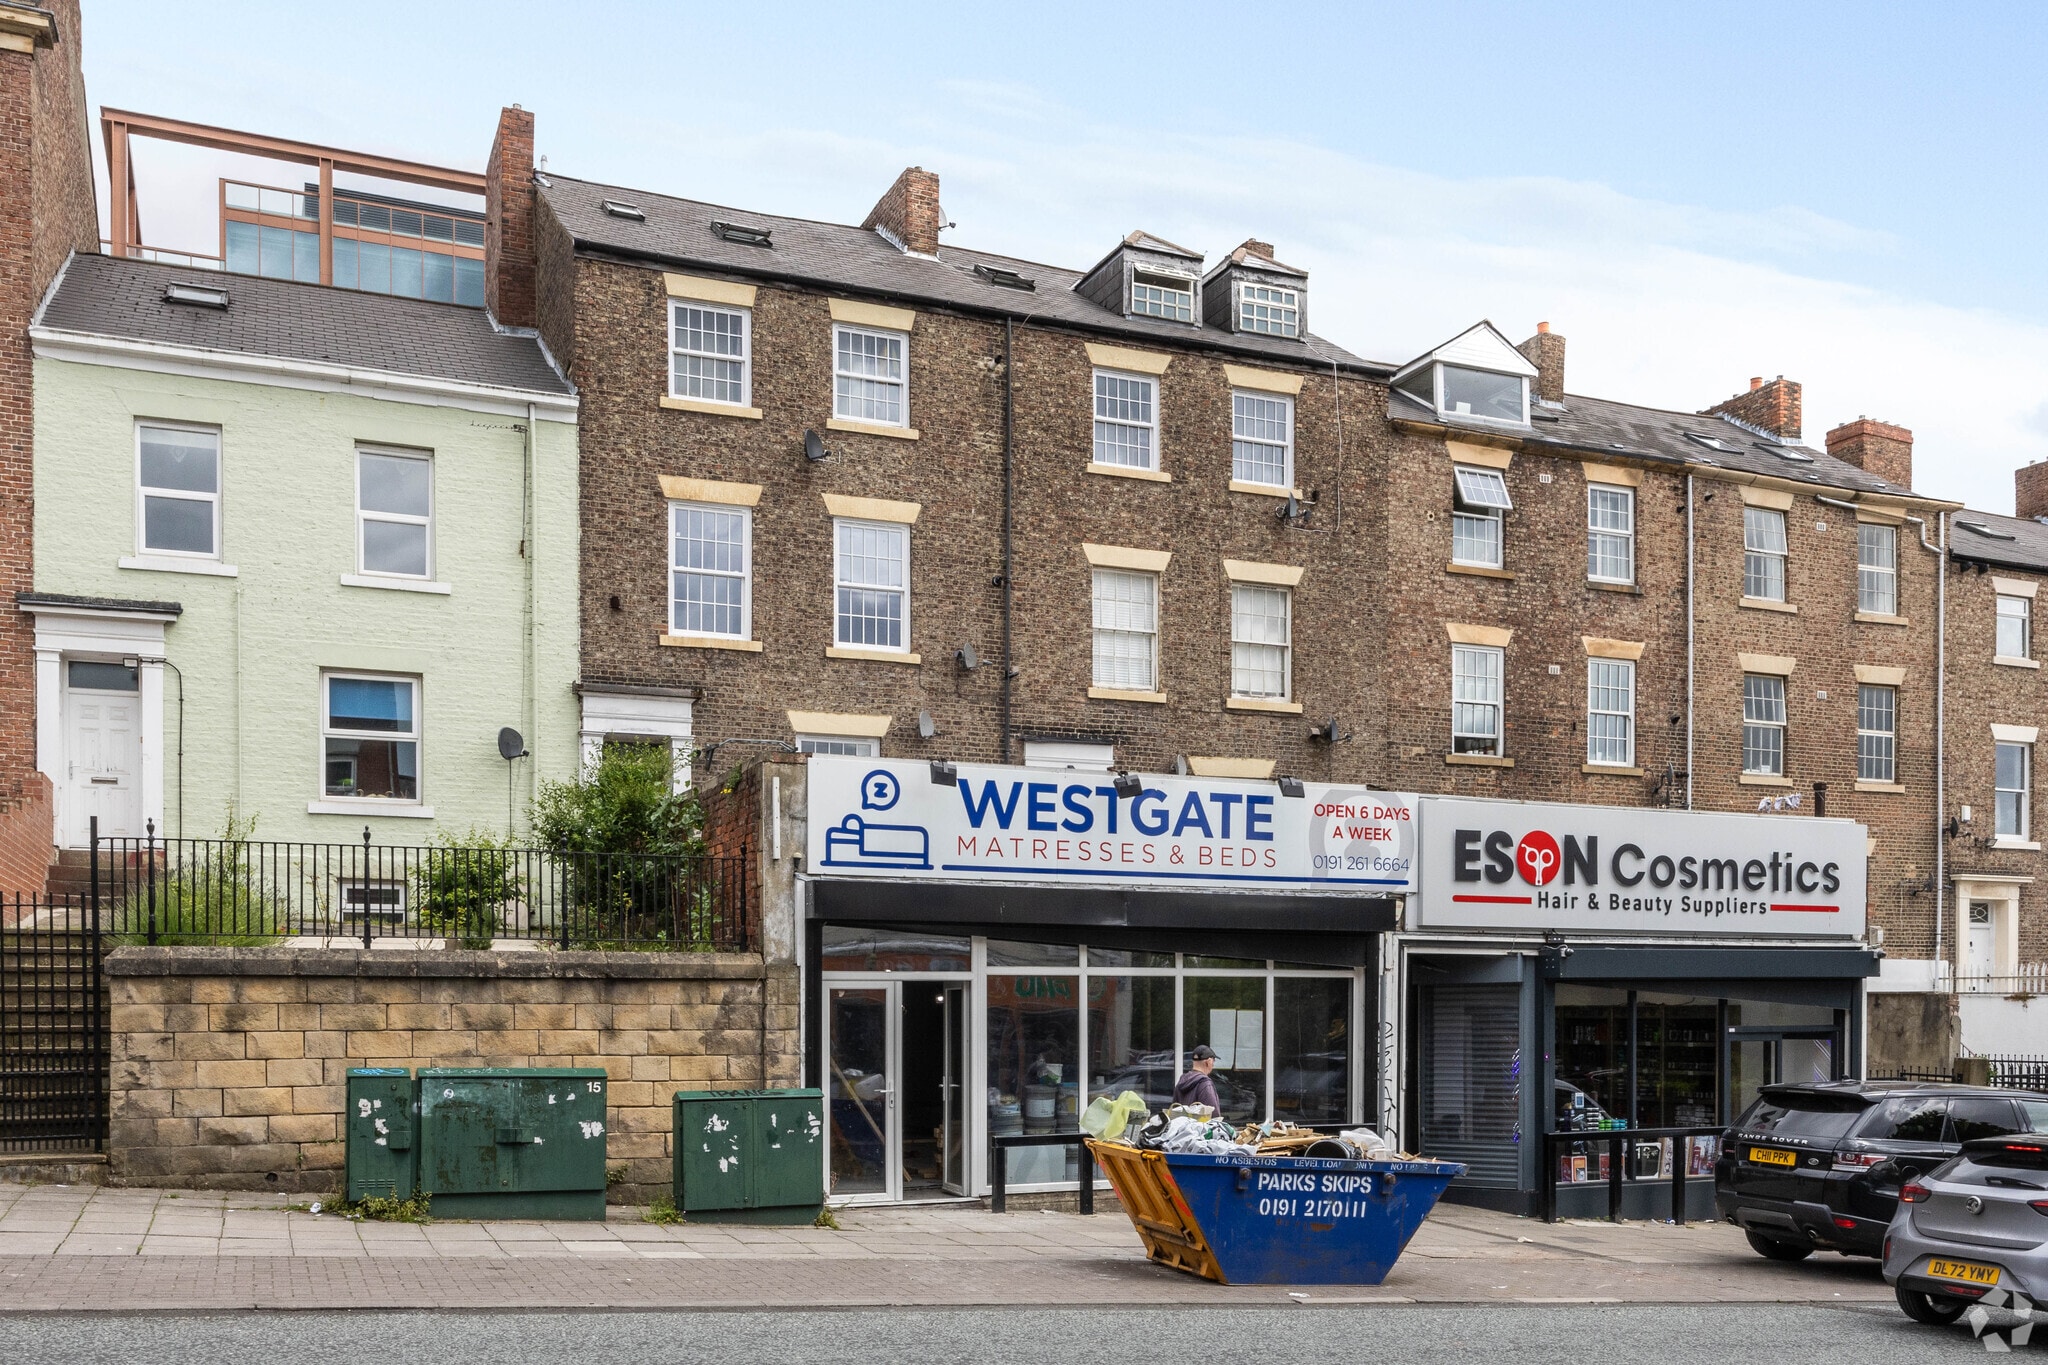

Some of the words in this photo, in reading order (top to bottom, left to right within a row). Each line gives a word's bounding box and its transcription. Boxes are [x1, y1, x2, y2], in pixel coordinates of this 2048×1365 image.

[957, 778, 1274, 841] WESTGATE
[1313, 803, 1355, 819] OPEN
[1360, 806, 1369, 819] 6
[1373, 806, 1410, 821] DAYS
[1332, 825, 1344, 839] A
[1348, 826, 1393, 841] WEEK
[957, 835, 1156, 864] MATRESSES
[1169, 844, 1185, 865] &
[1199, 845, 1277, 868] BEDS
[1313, 855, 1342, 869] 0191
[1347, 856, 1369, 871] 261
[1373, 857, 1410, 872] 6664
[1611, 843, 1841, 894] Cosmetics
[1537, 891, 1578, 909] Hair
[1587, 893, 1600, 910] &
[1609, 894, 1673, 916] Beauty
[1681, 896, 1768, 917] Suppliers
[586, 1081, 601, 1093] 15
[1772, 1136, 1808, 1145] ROVER
[1215, 1156, 1229, 1164] NO
[1231, 1157, 1277, 1166] ASBESTOS
[1294, 1159, 1319, 1168] LEVEL
[1772, 1152, 1790, 1163] PPK
[1258, 1173, 1315, 1192] PARKS
[1321, 1175, 1371, 1194] SKIPS
[1259, 1198, 1296, 1216] 0191
[1304, 1199, 1366, 1218] 2170111
[1933, 1261, 1966, 1278] DL72
[1969, 1266, 1995, 1282] YMY
